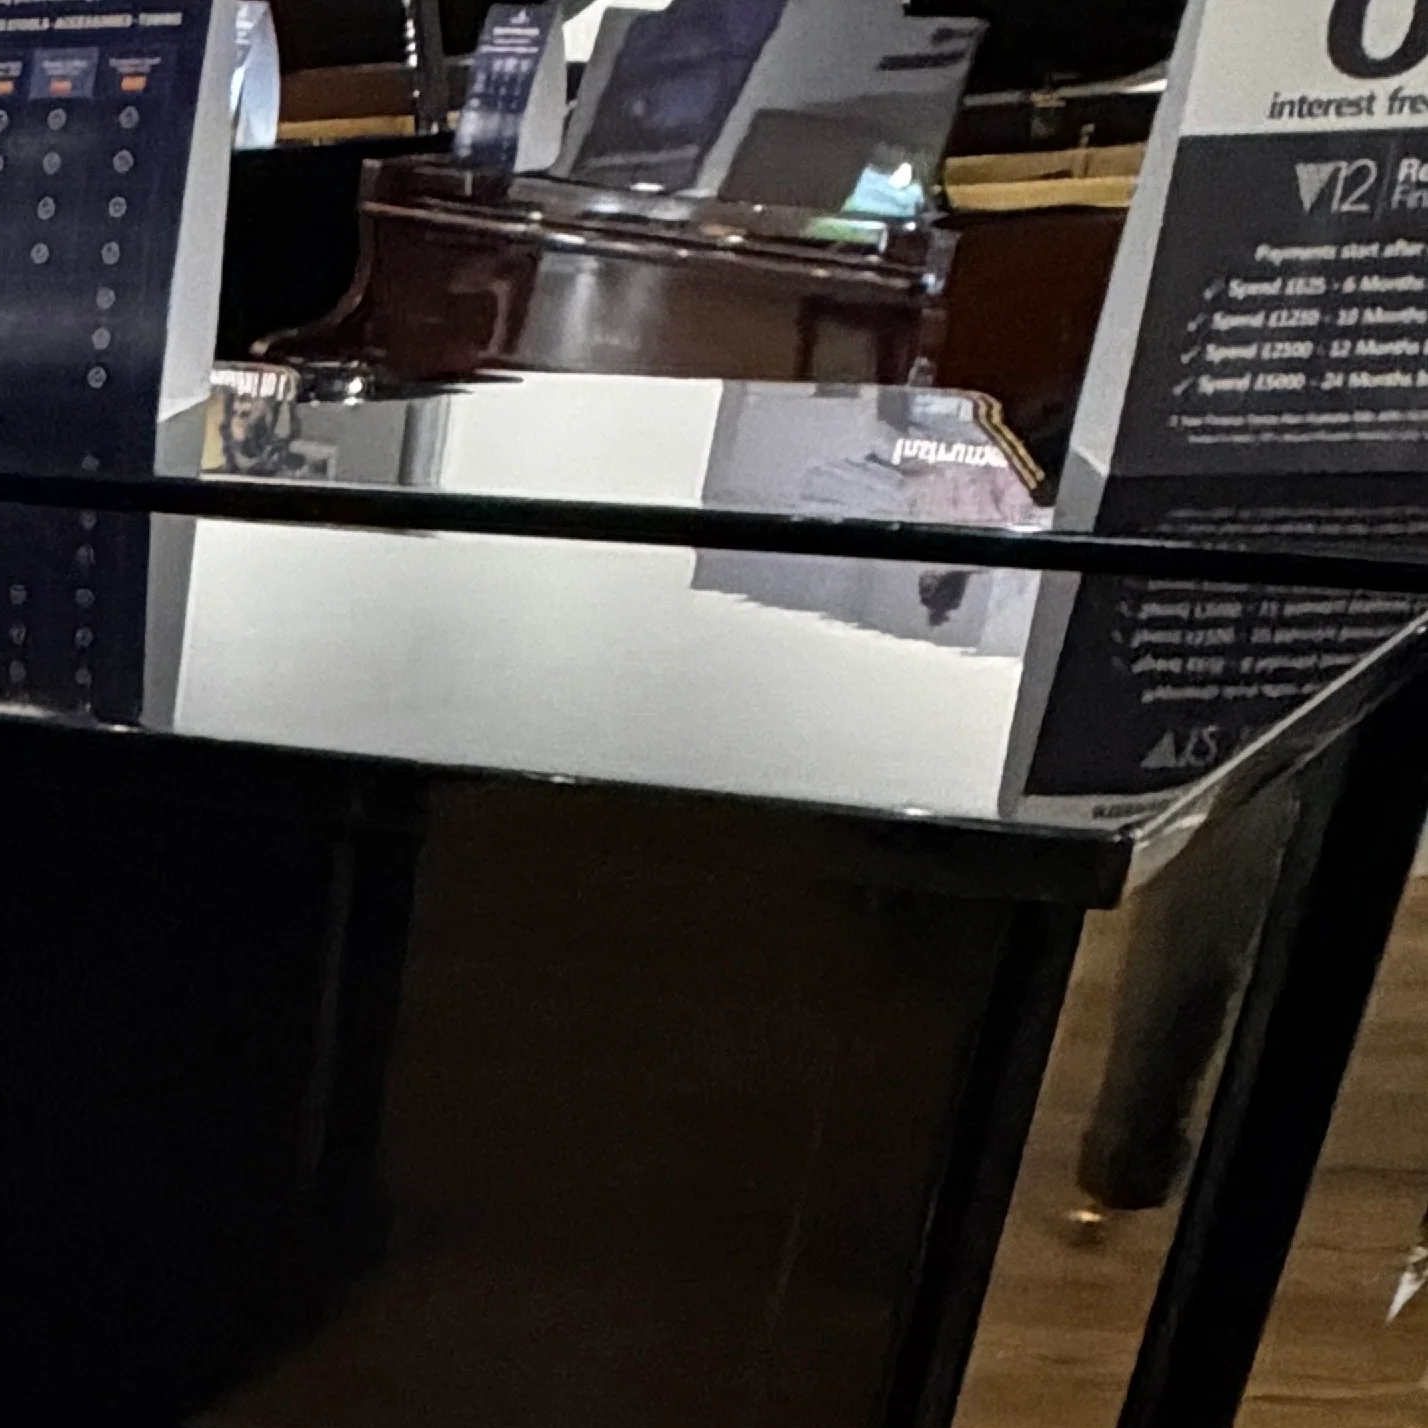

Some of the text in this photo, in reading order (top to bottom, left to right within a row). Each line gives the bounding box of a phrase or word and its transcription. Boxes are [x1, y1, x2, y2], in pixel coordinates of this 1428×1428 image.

[1267, 90, 1377, 120] interest
[1228, 276, 1282, 300] Spend
[1359, 274, 1425, 293] Months
[1211, 310, 1266, 331] Spend
[1361, 306, 1428, 325] Months
[1205, 342, 1259, 364] Spend
[1355, 337, 1420, 356] Months
[1198, 371, 1252, 395] Spend
[1348, 370, 1413, 389] Months
